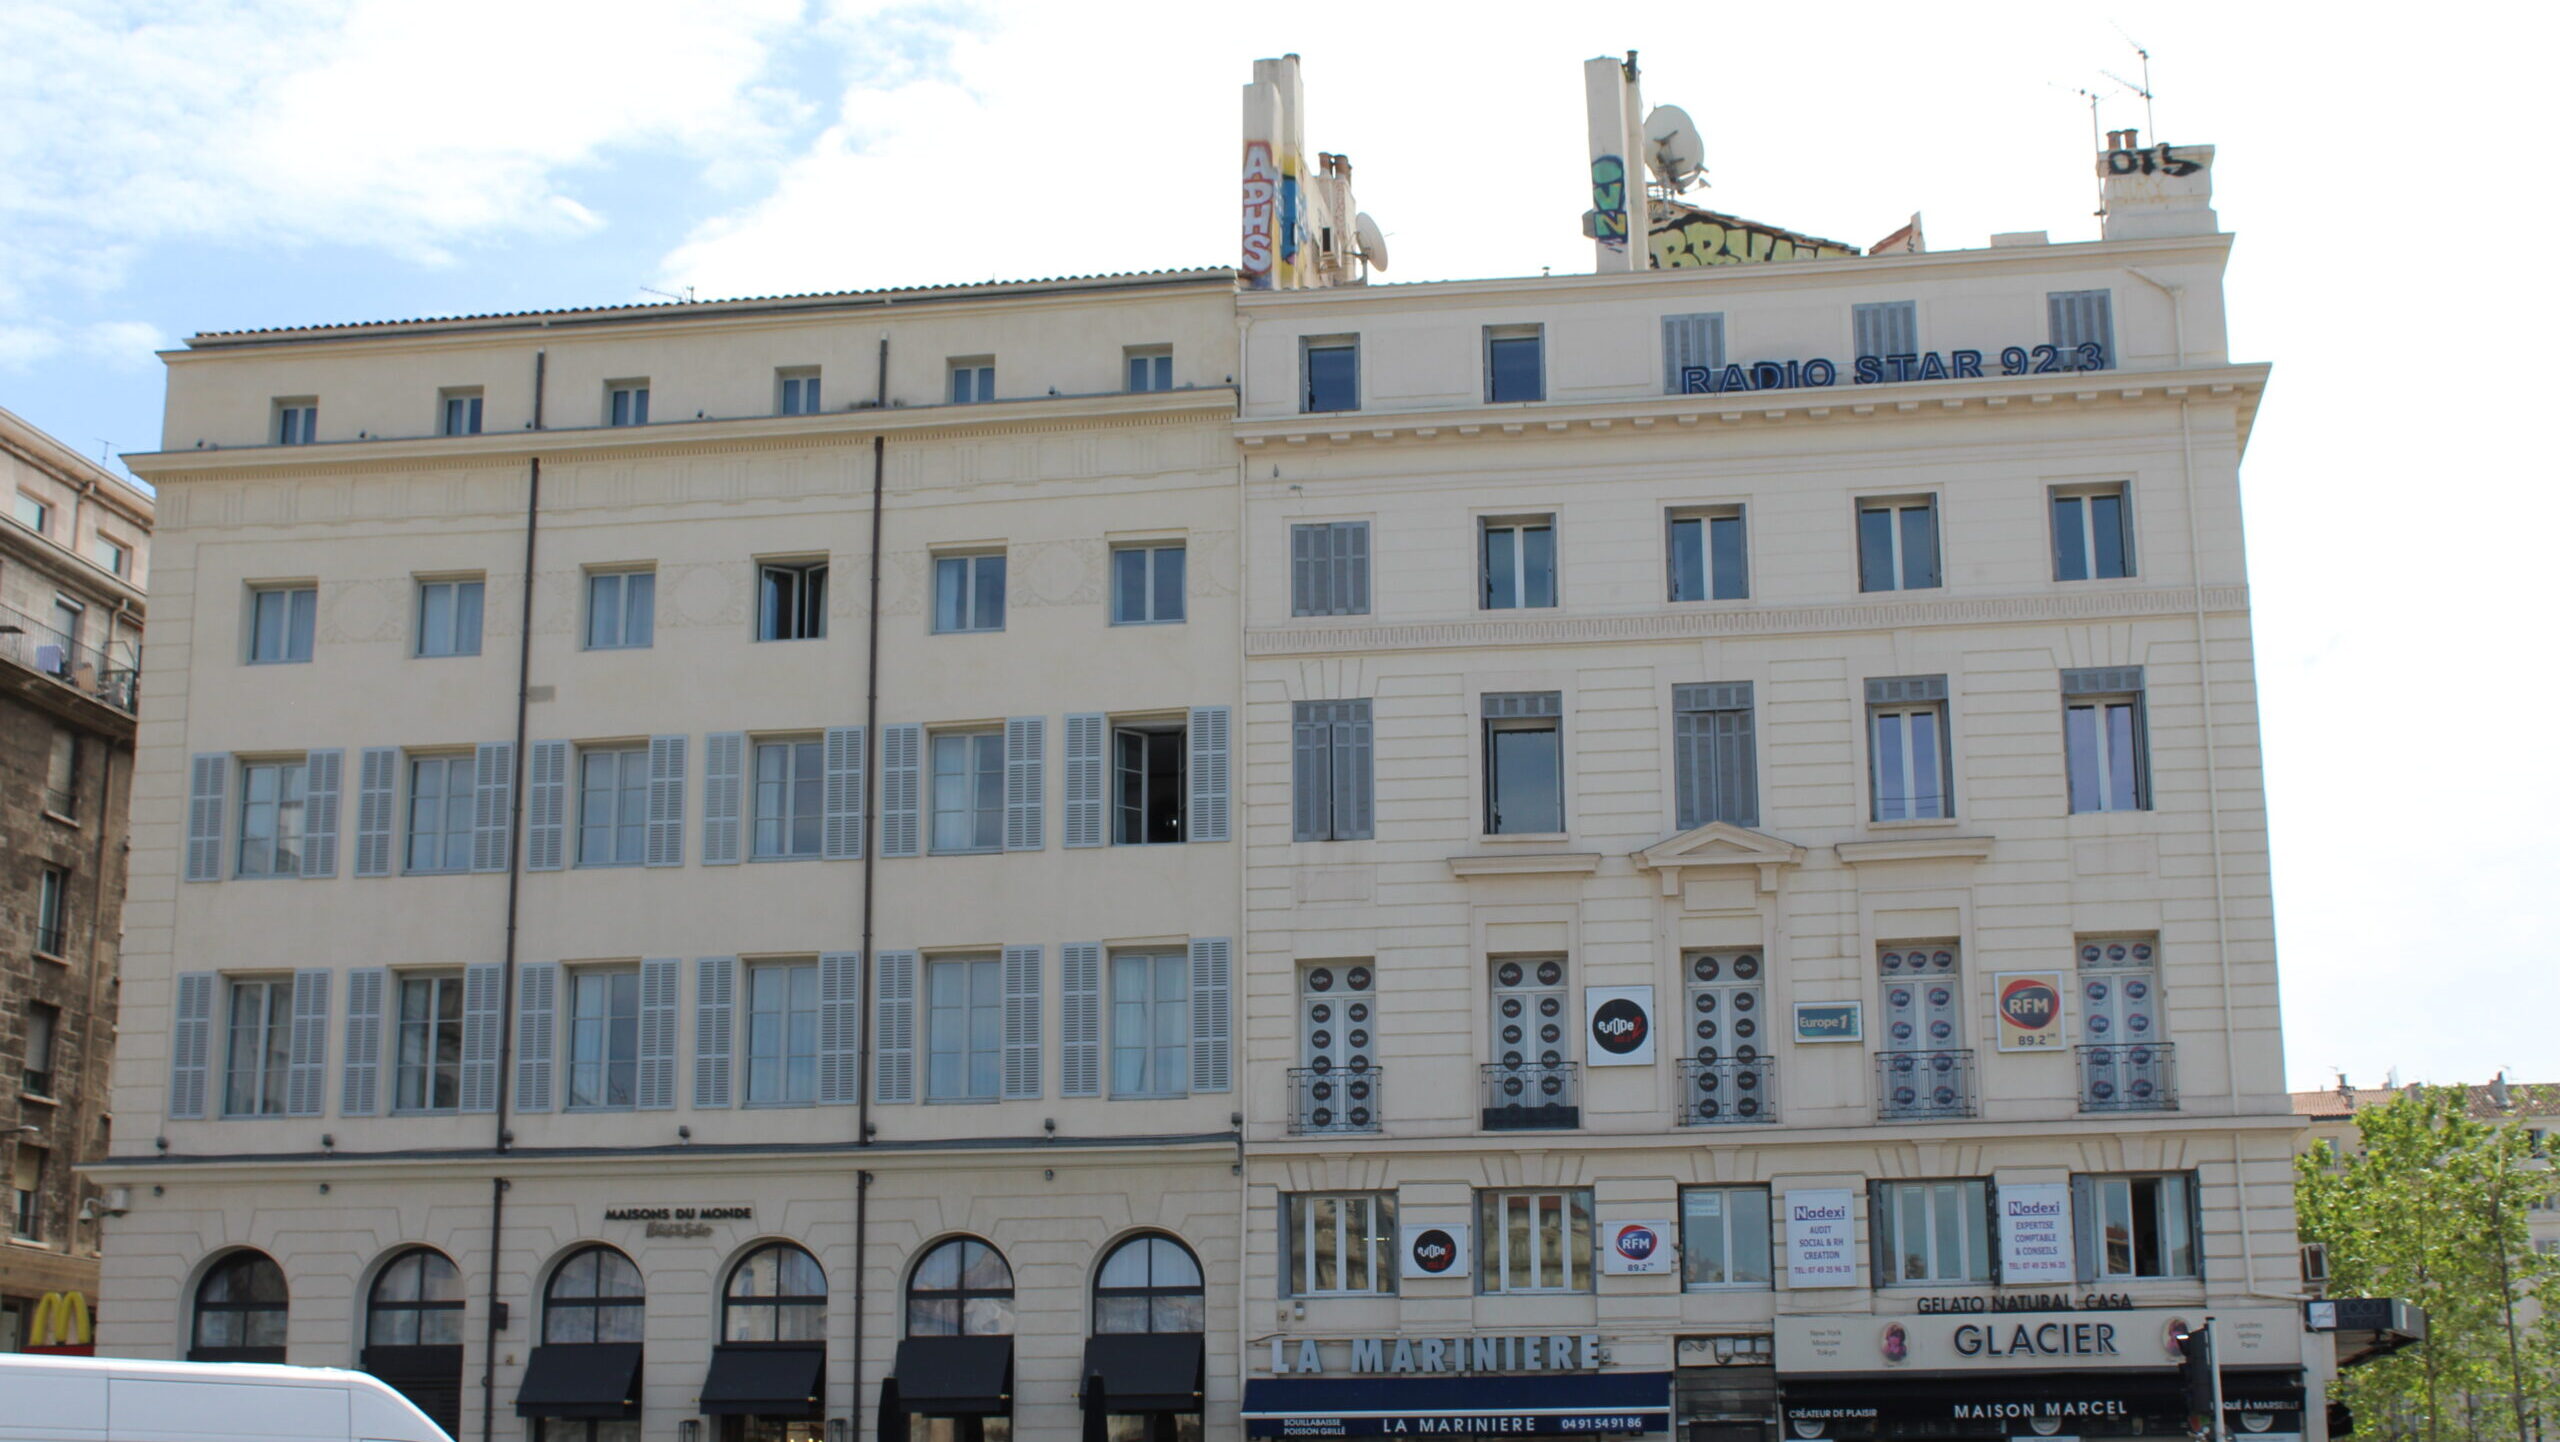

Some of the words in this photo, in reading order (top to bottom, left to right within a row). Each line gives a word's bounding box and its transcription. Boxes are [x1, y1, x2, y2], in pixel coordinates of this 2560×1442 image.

[1682, 358, 1836, 394] RADIO
[1854, 350, 1985, 385] STAR
[2000, 342, 2104, 377] 92.3
[2009, 998, 2049, 1014] RFM
[1799, 1016, 1839, 1030] Europe
[1839, 1014, 1848, 1029] 1
[2018, 1035, 2047, 1046] 89.2
[604, 1208, 670, 1220] MAISONS
[675, 1208, 696, 1220] DU
[700, 1207, 753, 1220] MONDE
[1794, 1205, 1846, 1220] Nadexi
[2008, 1201, 2060, 1215] Nadexi
[1810, 1225, 1832, 1234] AUDIT
[2015, 1221, 2054, 1230] EXPERTISE
[1622, 1238, 1650, 1250] RFM
[1799, 1238, 1825, 1247] SOCIAL
[2015, 1233, 2057, 1243] COMPTABLE
[1917, 1296, 1985, 1314] GELATO
[1991, 1294, 2075, 1313] NATURAL
[2084, 1293, 2134, 1310] CASA
[1954, 1323, 2118, 1357] GLACIER
[1271, 1339, 1322, 1374] LA
[1351, 1334, 1600, 1373] MARINIERE
[1832, 1409, 1845, 1417] DE
[1846, 1408, 1878, 1417] PLAISIR
[1954, 1402, 2035, 1419] MAISON
[2045, 1401, 2128, 1417] MARCEL
[1284, 1418, 1341, 1426] BOUILLABAISSE
[1383, 1418, 1407, 1433] LA
[1419, 1416, 1536, 1433] MARINIERE
[1561, 1419, 1576, 1430] 04
[1578, 1418, 1592, 1430] 91
[1594, 1418, 1610, 1429] 54
[1611, 1418, 1624, 1429] 91
[1627, 1417, 1642, 1428] 86
[1284, 1427, 1318, 1435] POISSON
